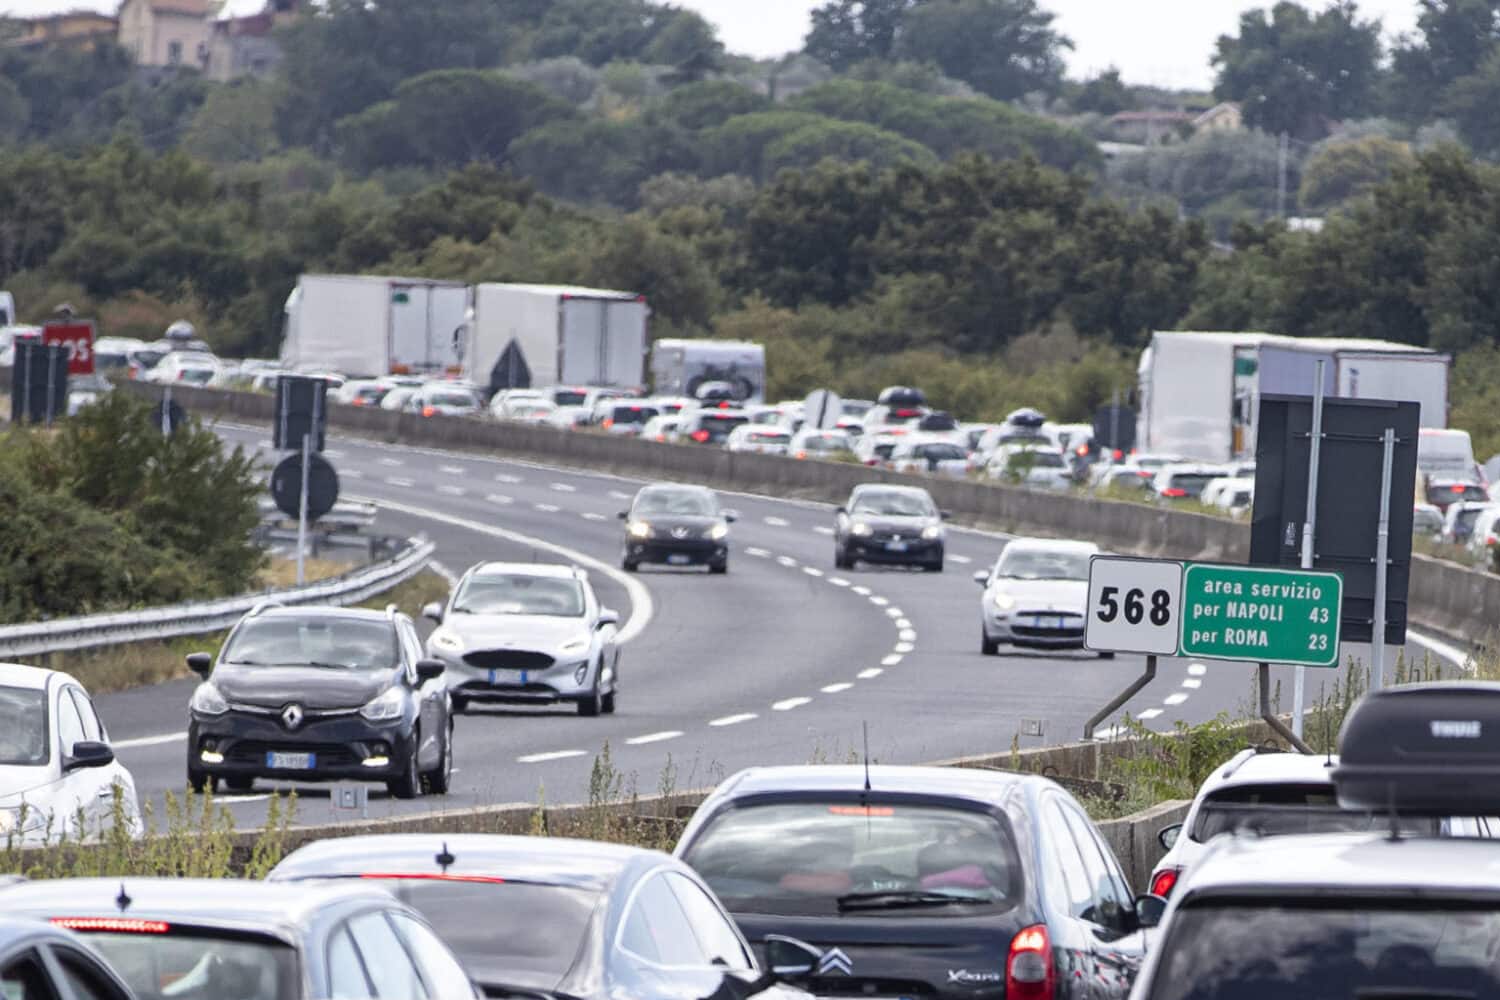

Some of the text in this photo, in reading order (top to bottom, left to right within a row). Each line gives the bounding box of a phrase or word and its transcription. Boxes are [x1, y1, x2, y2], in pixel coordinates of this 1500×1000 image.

[1204, 580, 1321, 600] area servizio
[1097, 586, 1170, 626] 568
[1193, 601, 1329, 623] per NAPOLI 43
[1191, 628, 1328, 650] per ROMA 23
